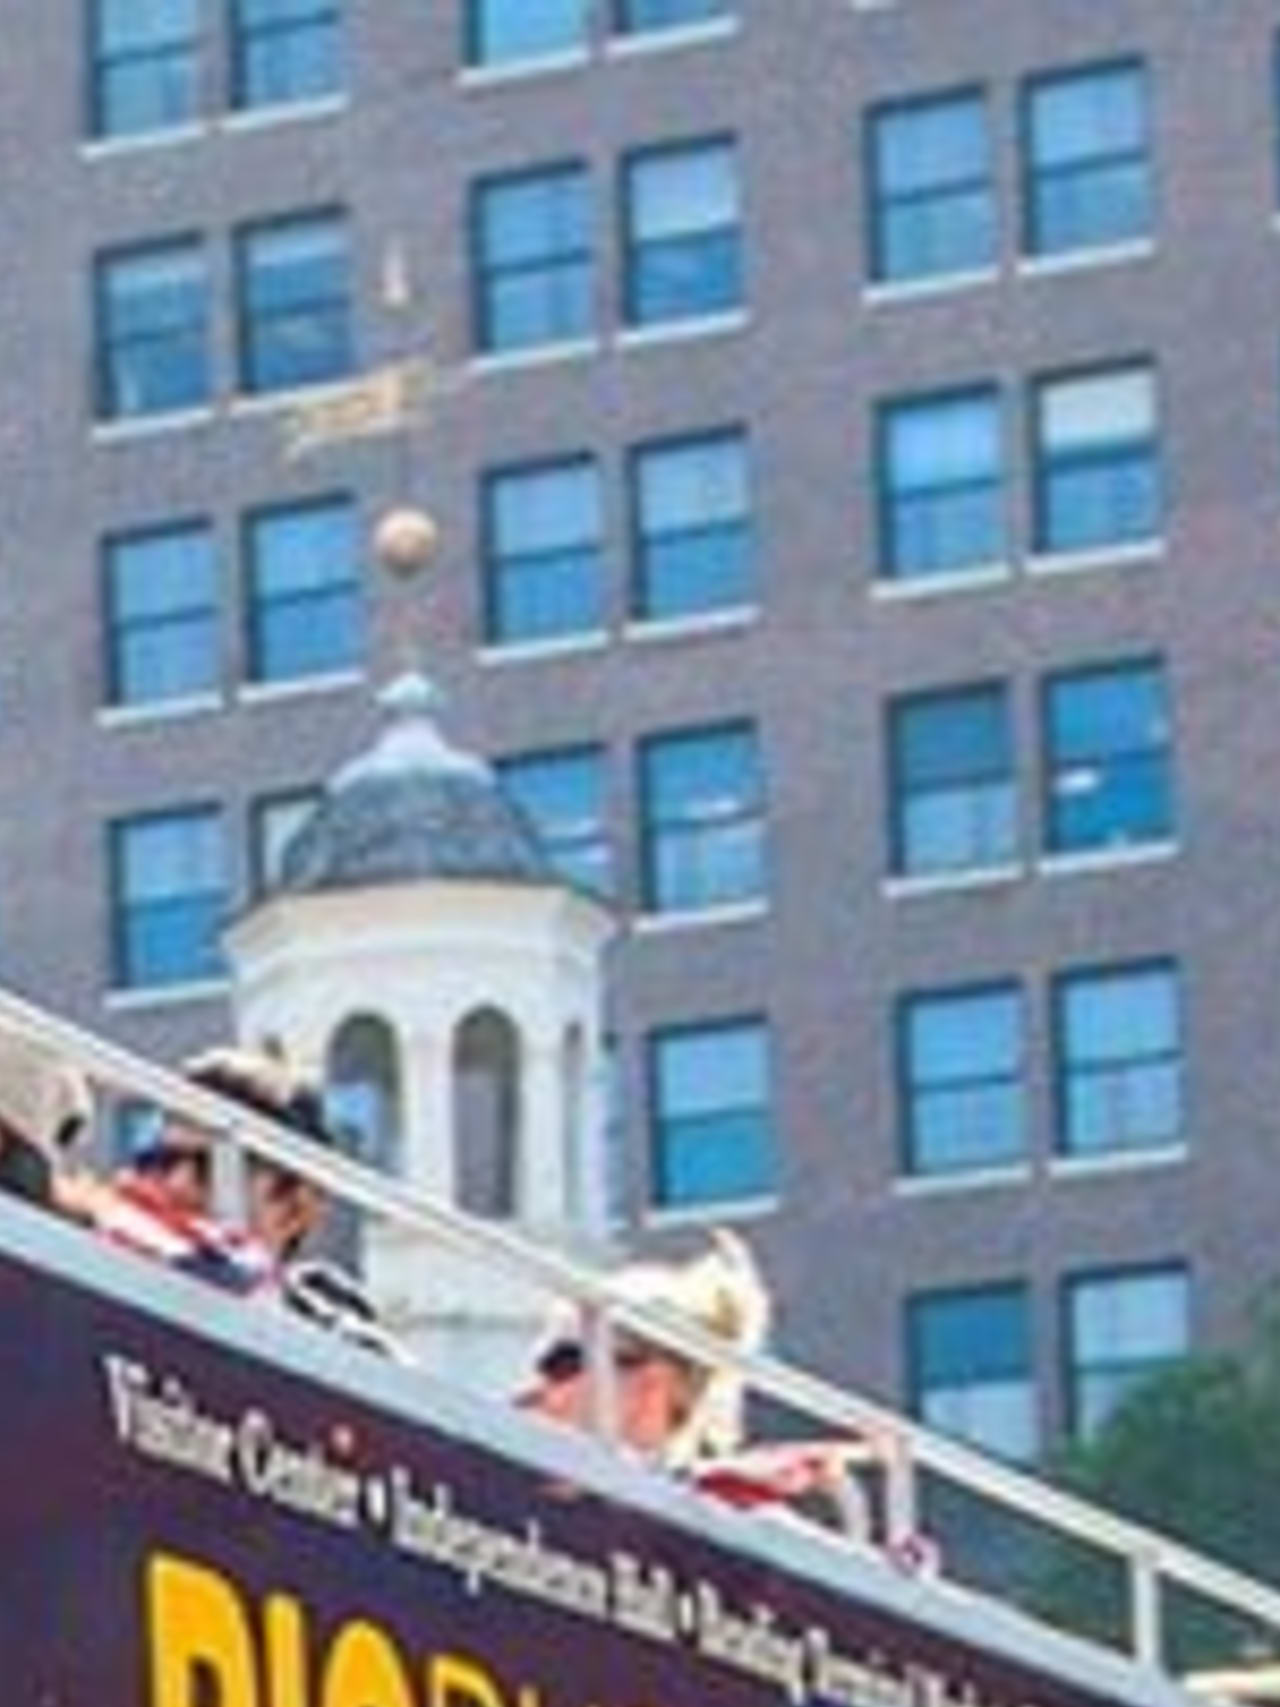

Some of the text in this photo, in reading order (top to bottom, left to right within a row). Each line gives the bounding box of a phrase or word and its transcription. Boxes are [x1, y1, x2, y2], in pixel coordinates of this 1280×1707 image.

[104, 1354, 233, 1483] Visitor
[237, 1407, 360, 1528] Center
[391, 1464, 611, 1624] Independence
[613, 1551, 678, 1643] Hall
